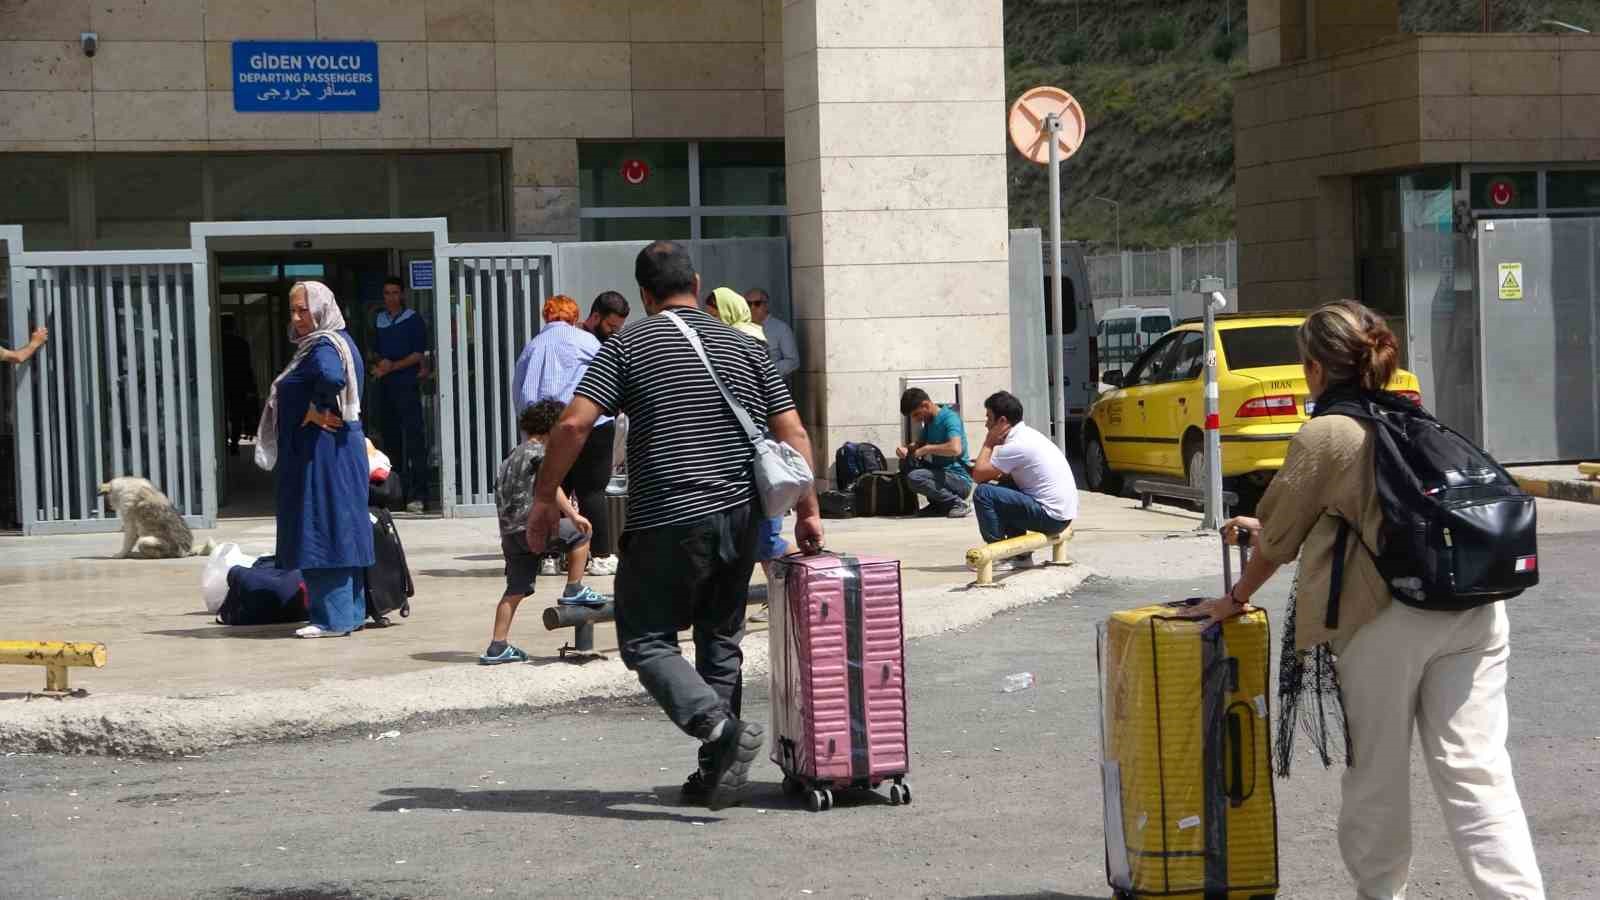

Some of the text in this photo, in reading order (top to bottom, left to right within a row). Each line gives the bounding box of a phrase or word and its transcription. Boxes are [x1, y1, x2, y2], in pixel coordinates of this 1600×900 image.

[250, 52, 361, 70] GİDEN YOLCU
[239, 72, 373, 83] DEPARTING PASSENGERS
[317, 83, 357, 100] مسافر
[1271, 380, 1293, 390] IRAN
